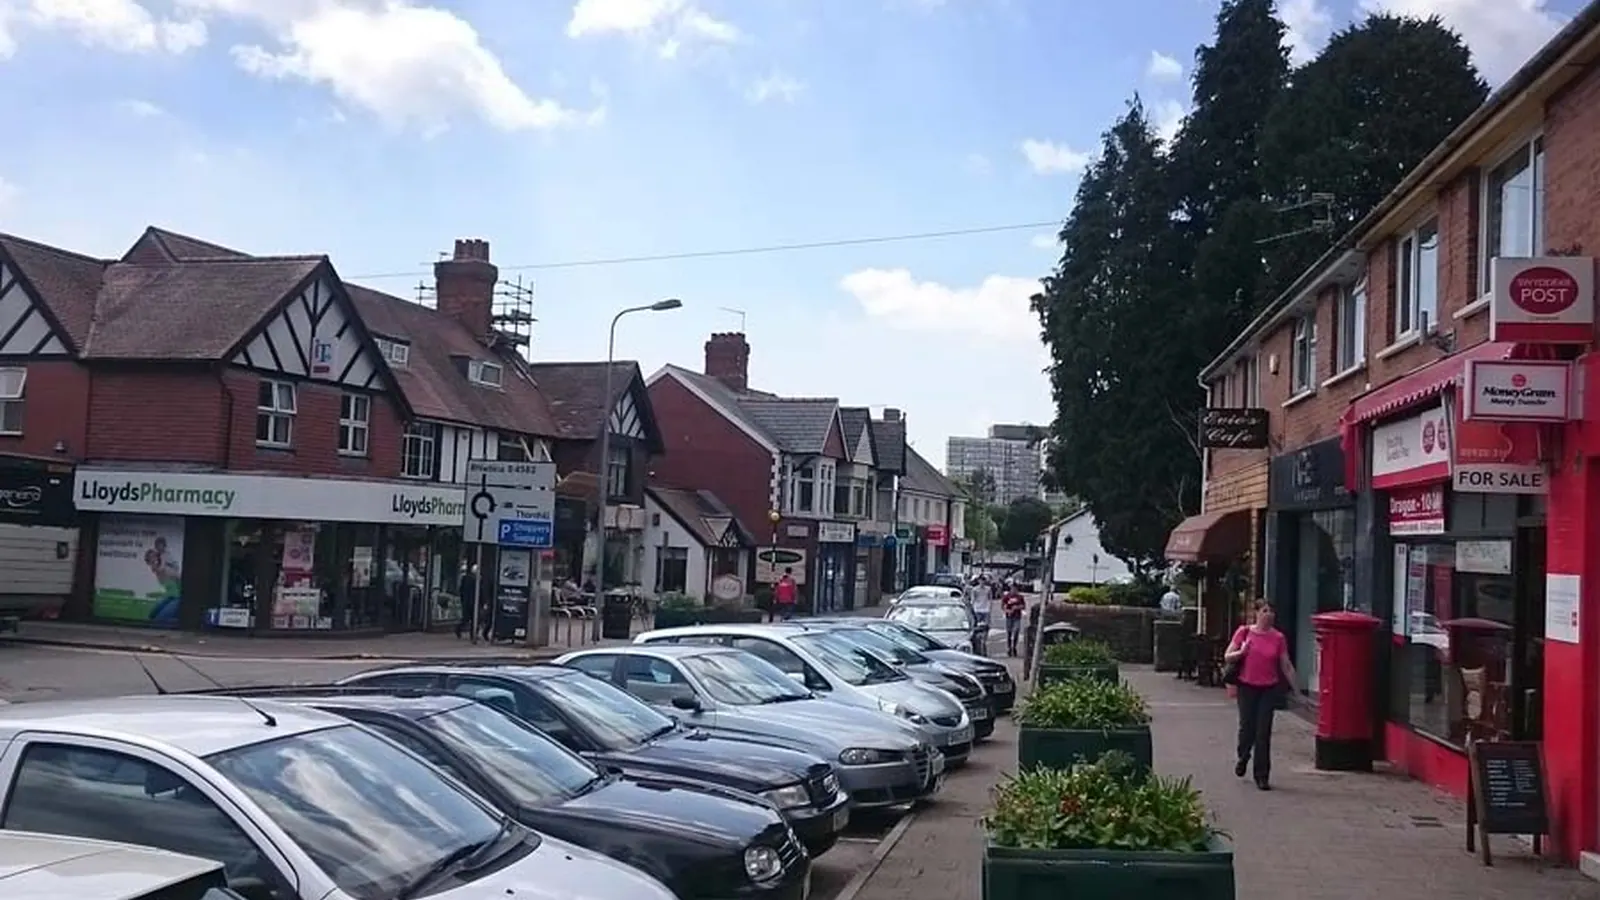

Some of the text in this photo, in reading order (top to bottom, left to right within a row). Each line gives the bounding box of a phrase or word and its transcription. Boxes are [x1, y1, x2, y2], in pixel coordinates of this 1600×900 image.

[1521, 288, 1569, 303] POST
[1482, 386, 1556, 398] MoneyGram
[1458, 471, 1544, 488] FOR SALE
[82, 480, 235, 510] LloydsPharmacy
